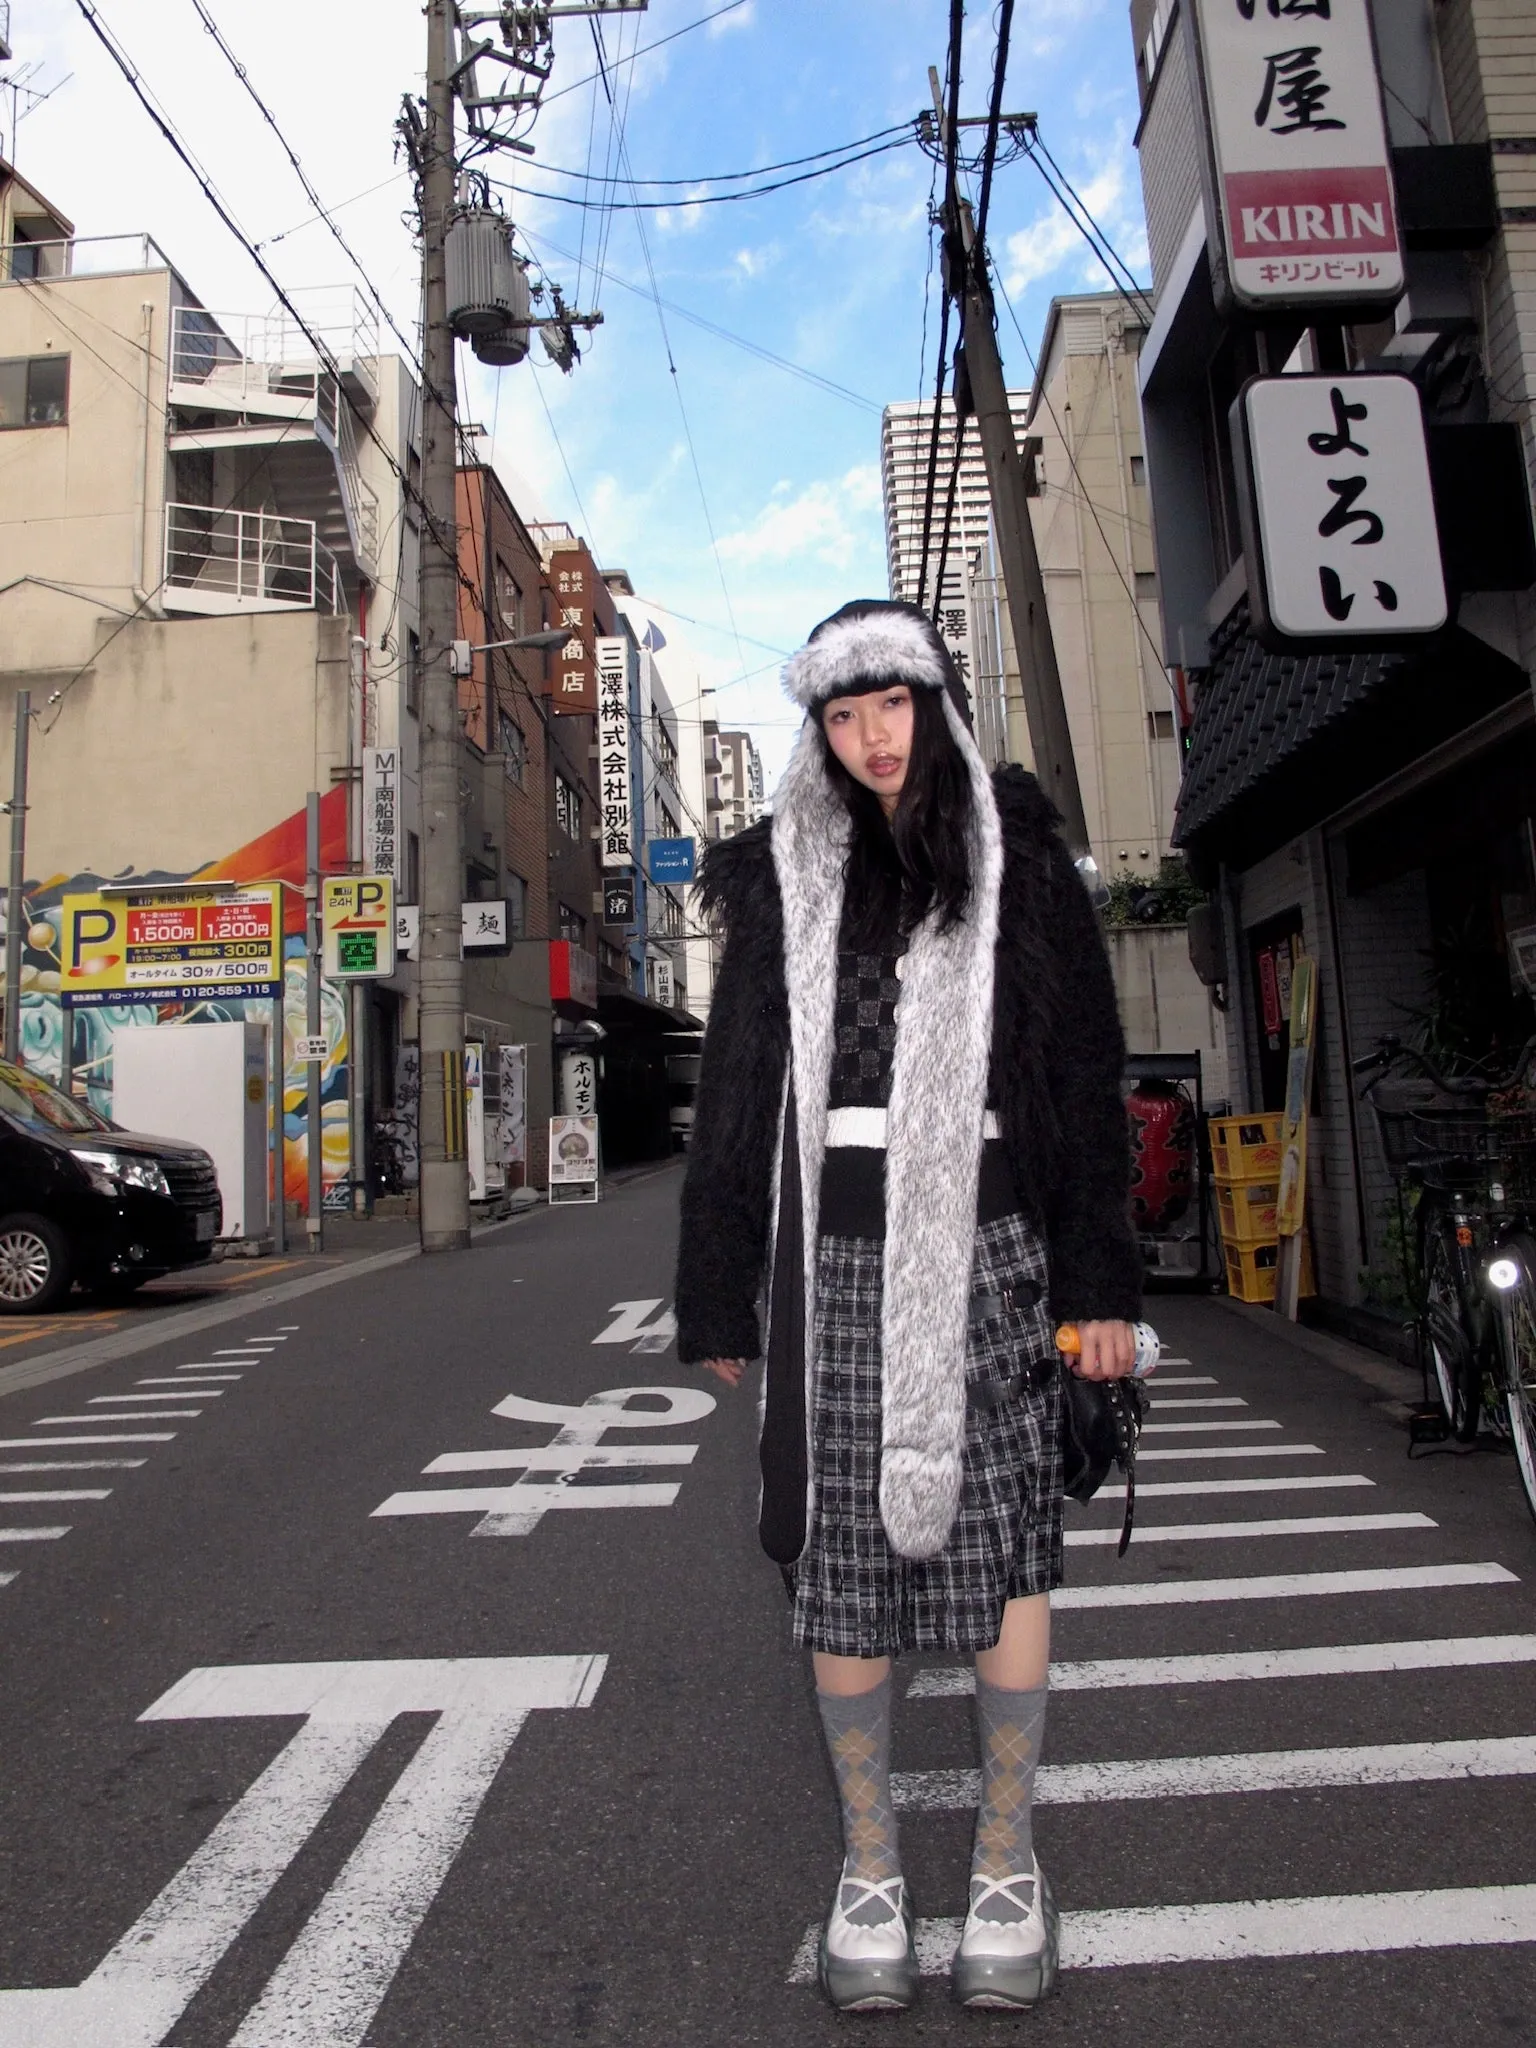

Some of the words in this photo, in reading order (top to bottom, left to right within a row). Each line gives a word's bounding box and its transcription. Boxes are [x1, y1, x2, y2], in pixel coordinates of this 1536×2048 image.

[1237, 0, 1347, 135] 屋
[1241, 202, 1386, 244] KIRIN
[1259, 261, 1379, 284] キリンビール
[1307, 387, 1398, 622] よろい
[559, 607, 586, 693] 東商店
[601, 646, 629, 855] 三澤株式会社別館
[375, 753, 394, 875] MT南船場治療
[329, 897, 352, 907] 24H
[357, 883, 383, 917] P
[72, 909, 117, 969] P
[132, 926, 195, 943] 1,500円
[207, 922, 269, 939] 1,200円
[224, 943, 268, 957] 300円
[340, 933, 378, 971] 空
[130, 969, 177, 979] オールタイム
[182, 984, 270, 998] 0120-559-115
[658, 966, 669, 1005] 杉山商店
[573, 1061, 592, 1115] ホルモン
